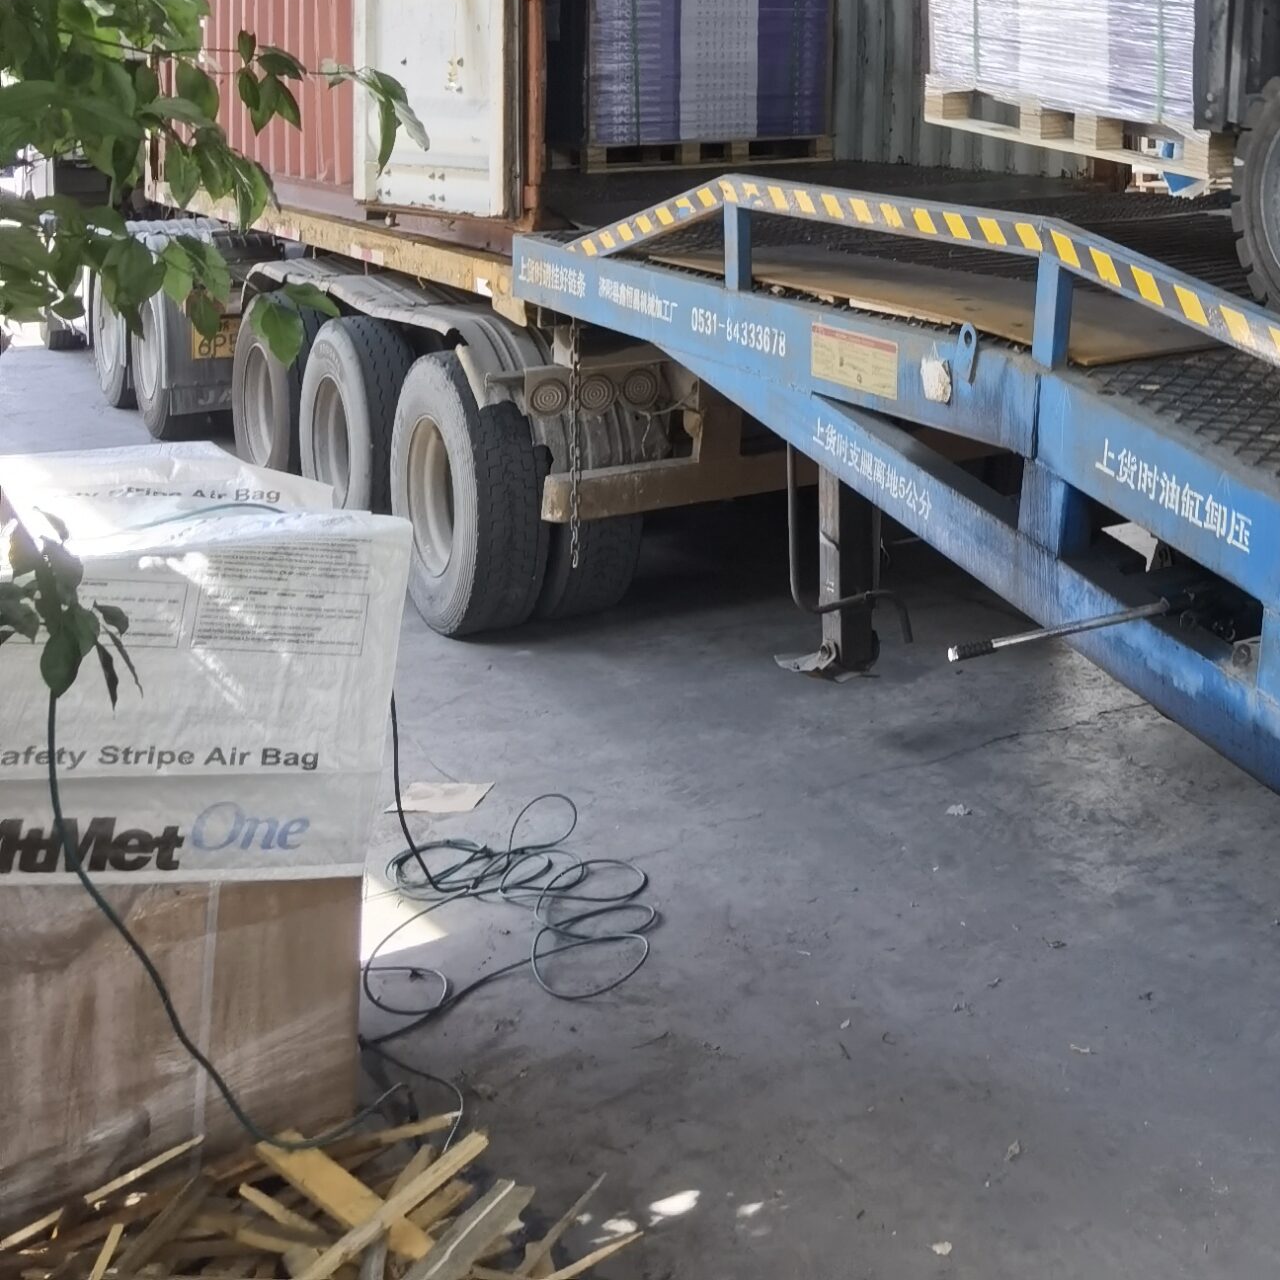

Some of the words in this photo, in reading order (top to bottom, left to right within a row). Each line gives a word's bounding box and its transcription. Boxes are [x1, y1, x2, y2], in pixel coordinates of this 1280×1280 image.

[691, 307, 787, 357] 0531-84333678
[235, 488, 281, 503] Bag
[1095, 438, 1252, 554] 上货时油缸卸压
[0, 745, 86, 770] afety
[98, 745, 194, 771] Stripe
[204, 746, 251, 766] Air
[261, 747, 319, 771] Bag
[191, 801, 310, 852] One
